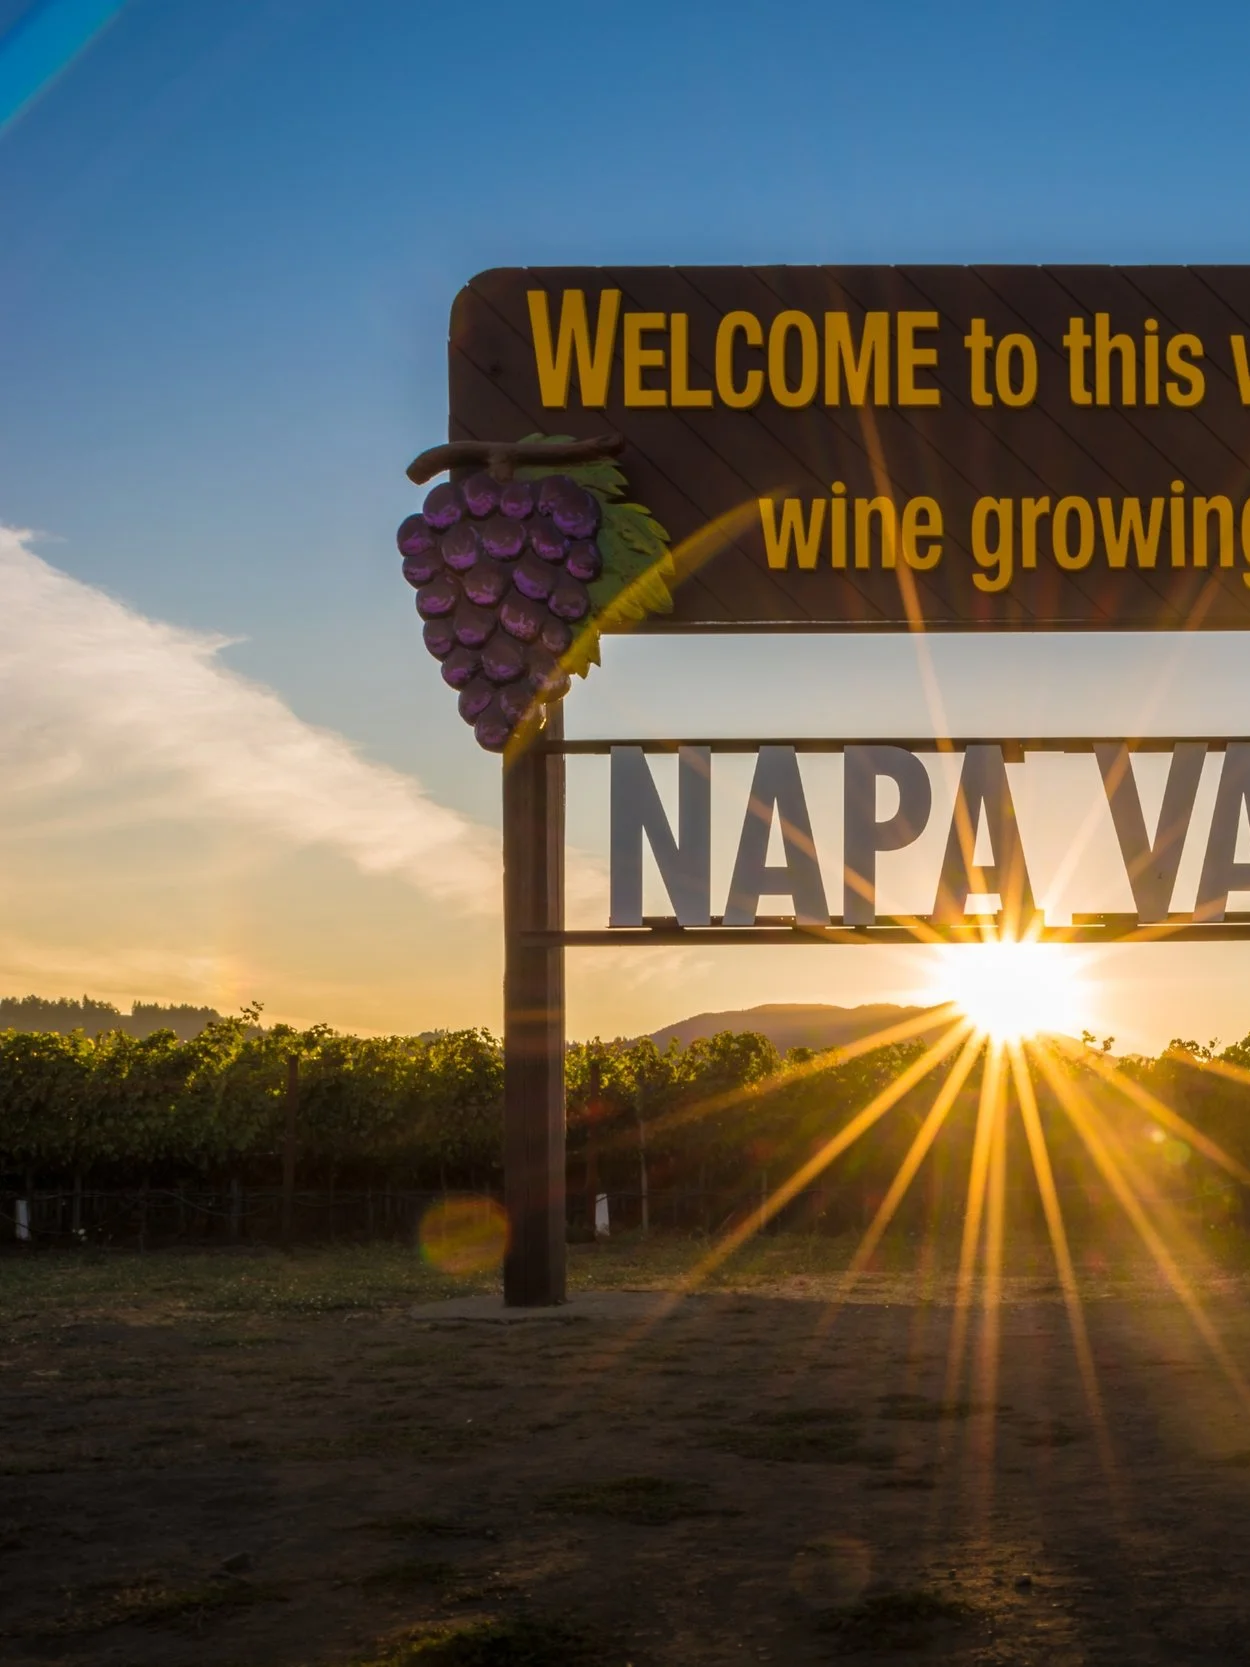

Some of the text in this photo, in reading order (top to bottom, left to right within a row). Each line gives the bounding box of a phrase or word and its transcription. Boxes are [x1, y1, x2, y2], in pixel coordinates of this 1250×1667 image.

[526, 288, 941, 409] WELCOME
[964, 318, 1038, 409] to
[1063, 313, 1204, 408] this
[759, 481, 944, 571] wine
[609, 744, 1036, 927] NAPA
